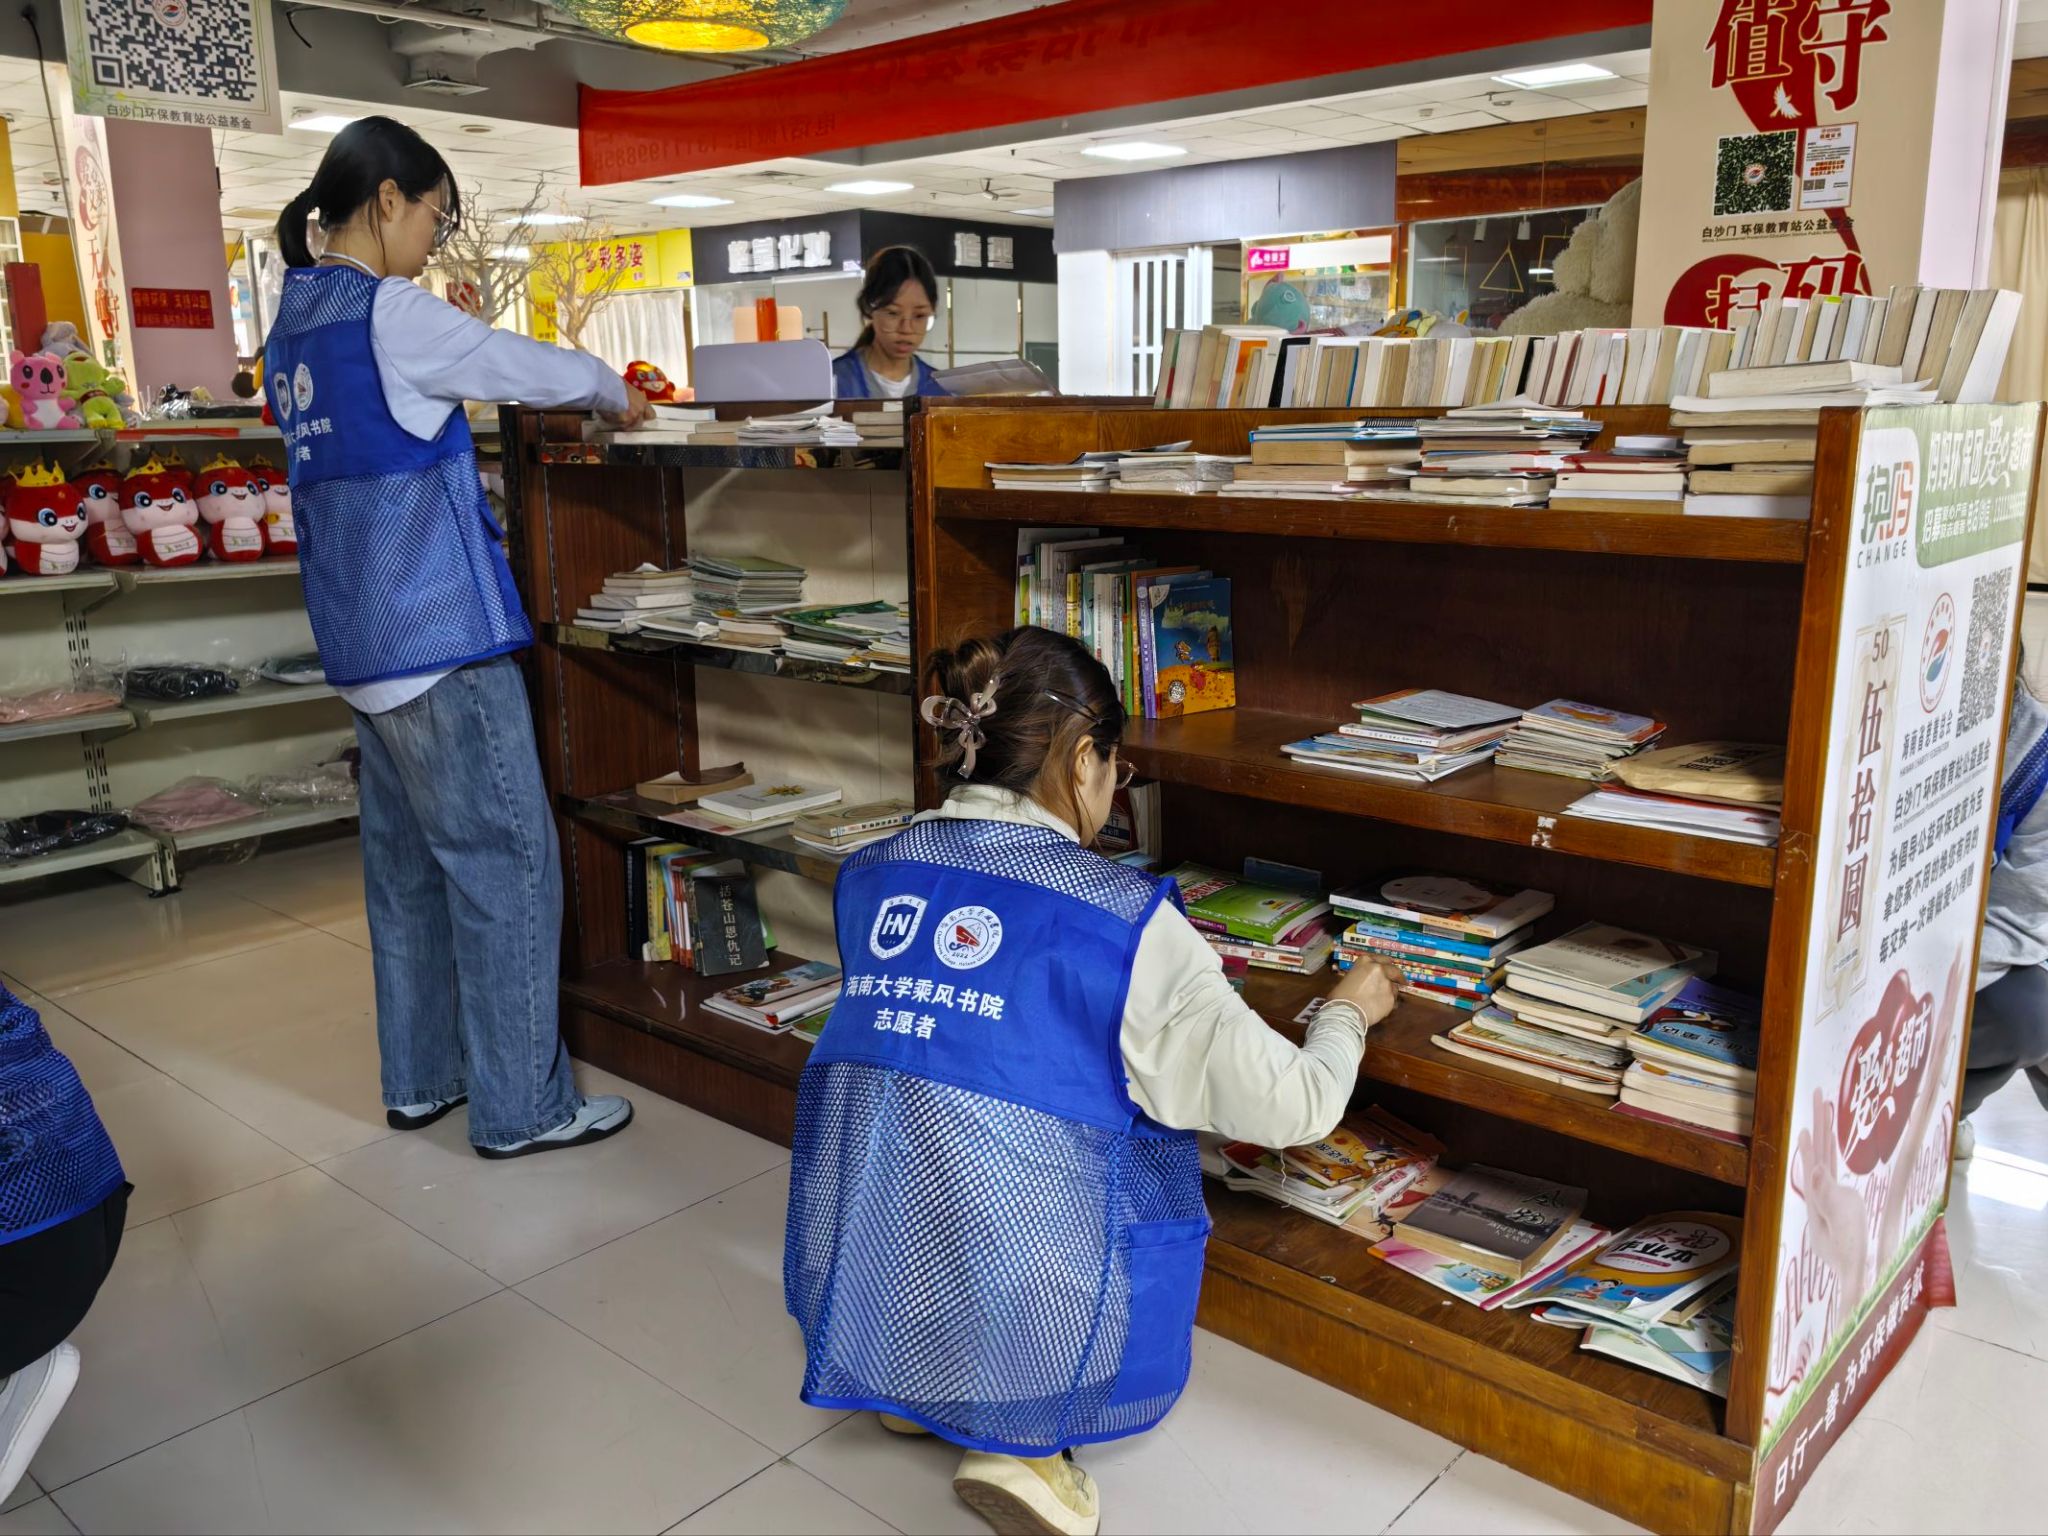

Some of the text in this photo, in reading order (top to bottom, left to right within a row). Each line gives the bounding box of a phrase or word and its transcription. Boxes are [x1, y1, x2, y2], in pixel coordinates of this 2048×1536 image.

[1705, 0, 1892, 111] 值守
[106, 104, 252, 130] 白沙门环保教育站公益基金
[1702, 226, 1737, 238] 白沙门
[1741, 217, 1854, 236] 环保教育站公益基金
[585, 242, 642, 273] 多彩多姿
[1857, 540, 1907, 568] CHANGE
[1872, 628, 1890, 662] 50
[1895, 782, 1921, 822] 白沙门
[1923, 737, 1991, 802] 环保教育站公益基金
[881, 913, 912, 936] HN
[845, 973, 1005, 1020] 海南大学乘风书院
[873, 1007, 937, 1040] 志愿者
[1843, 1002, 1931, 1162] 爱心超市
[1773, 1381, 1840, 1506] 日行一善
